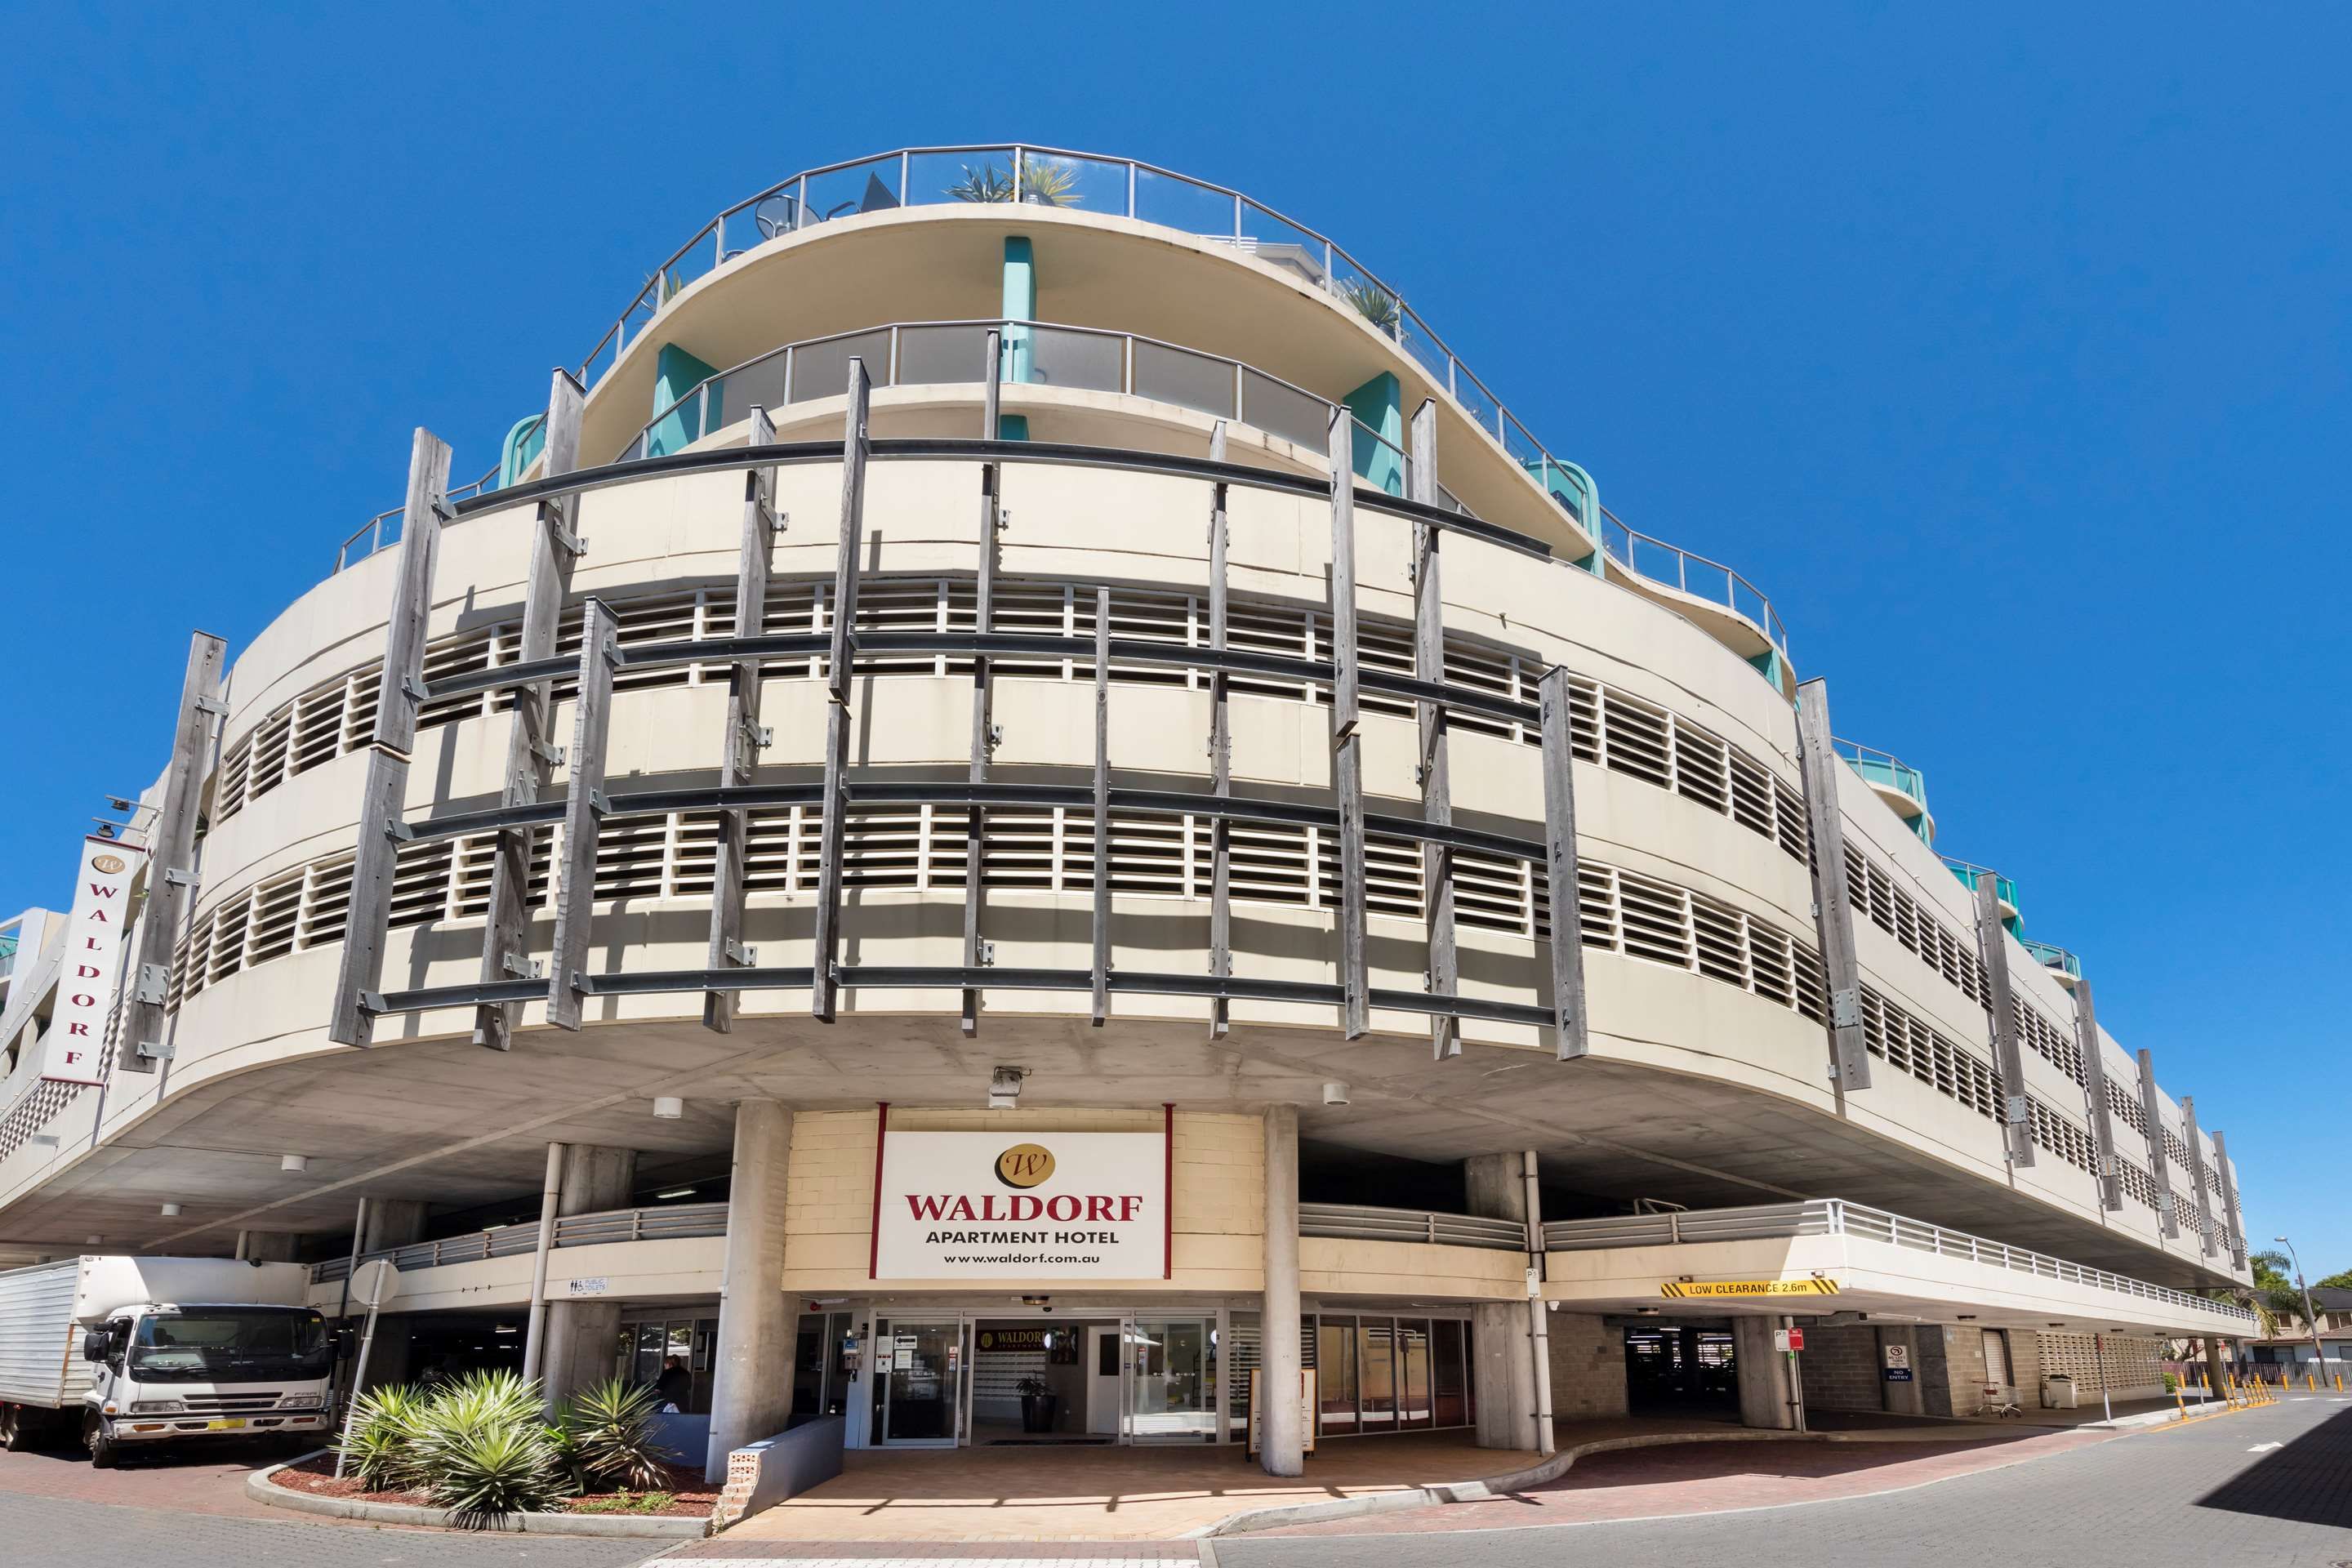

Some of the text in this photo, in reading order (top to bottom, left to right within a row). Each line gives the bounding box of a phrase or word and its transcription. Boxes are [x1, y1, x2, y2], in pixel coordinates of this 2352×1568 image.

[65, 883, 118, 1065] WALDORF
[1004, 1152, 1049, 1177] W
[904, 1194, 1143, 1223] WALDORF
[925, 1231, 1120, 1245] APARTMENT HOTEL
[943, 1253, 1101, 1264] www.waldorf.com.au
[1689, 1282, 1807, 1295] LOW CLEARANCE 2.6m
